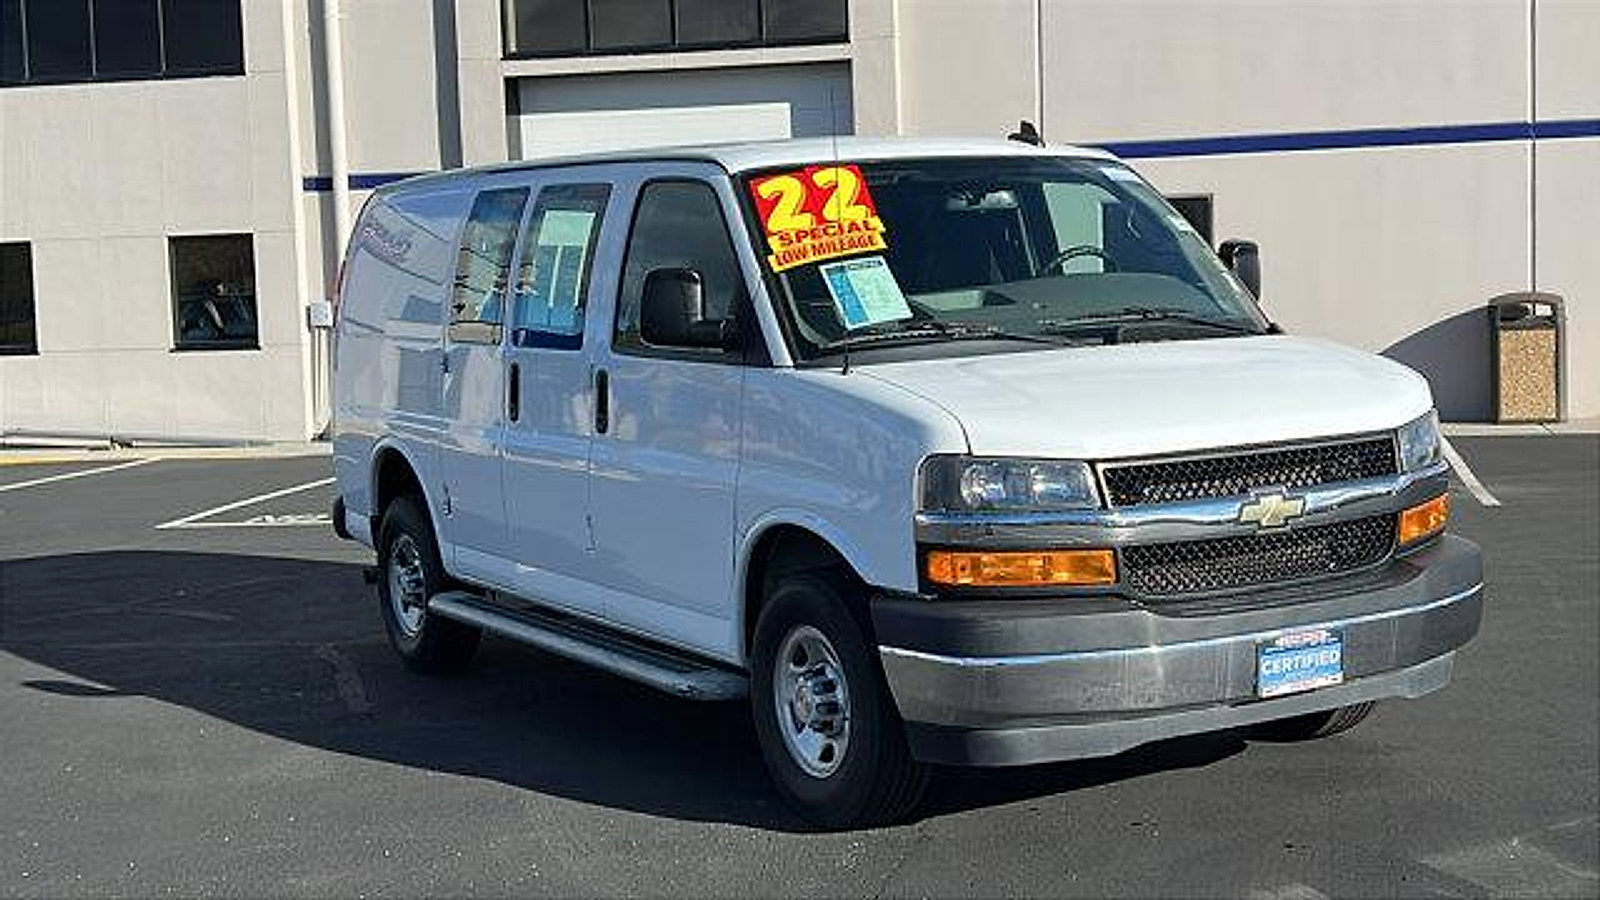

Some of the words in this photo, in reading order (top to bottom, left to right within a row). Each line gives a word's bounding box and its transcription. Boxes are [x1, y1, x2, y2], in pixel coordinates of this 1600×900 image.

[758, 167, 872, 232] 22
[778, 219, 878, 246] SPECIAL
[775, 246, 809, 266] LOW
[811, 234, 879, 257] MILEAGE
[1260, 650, 1341, 675] CERTIFIED
